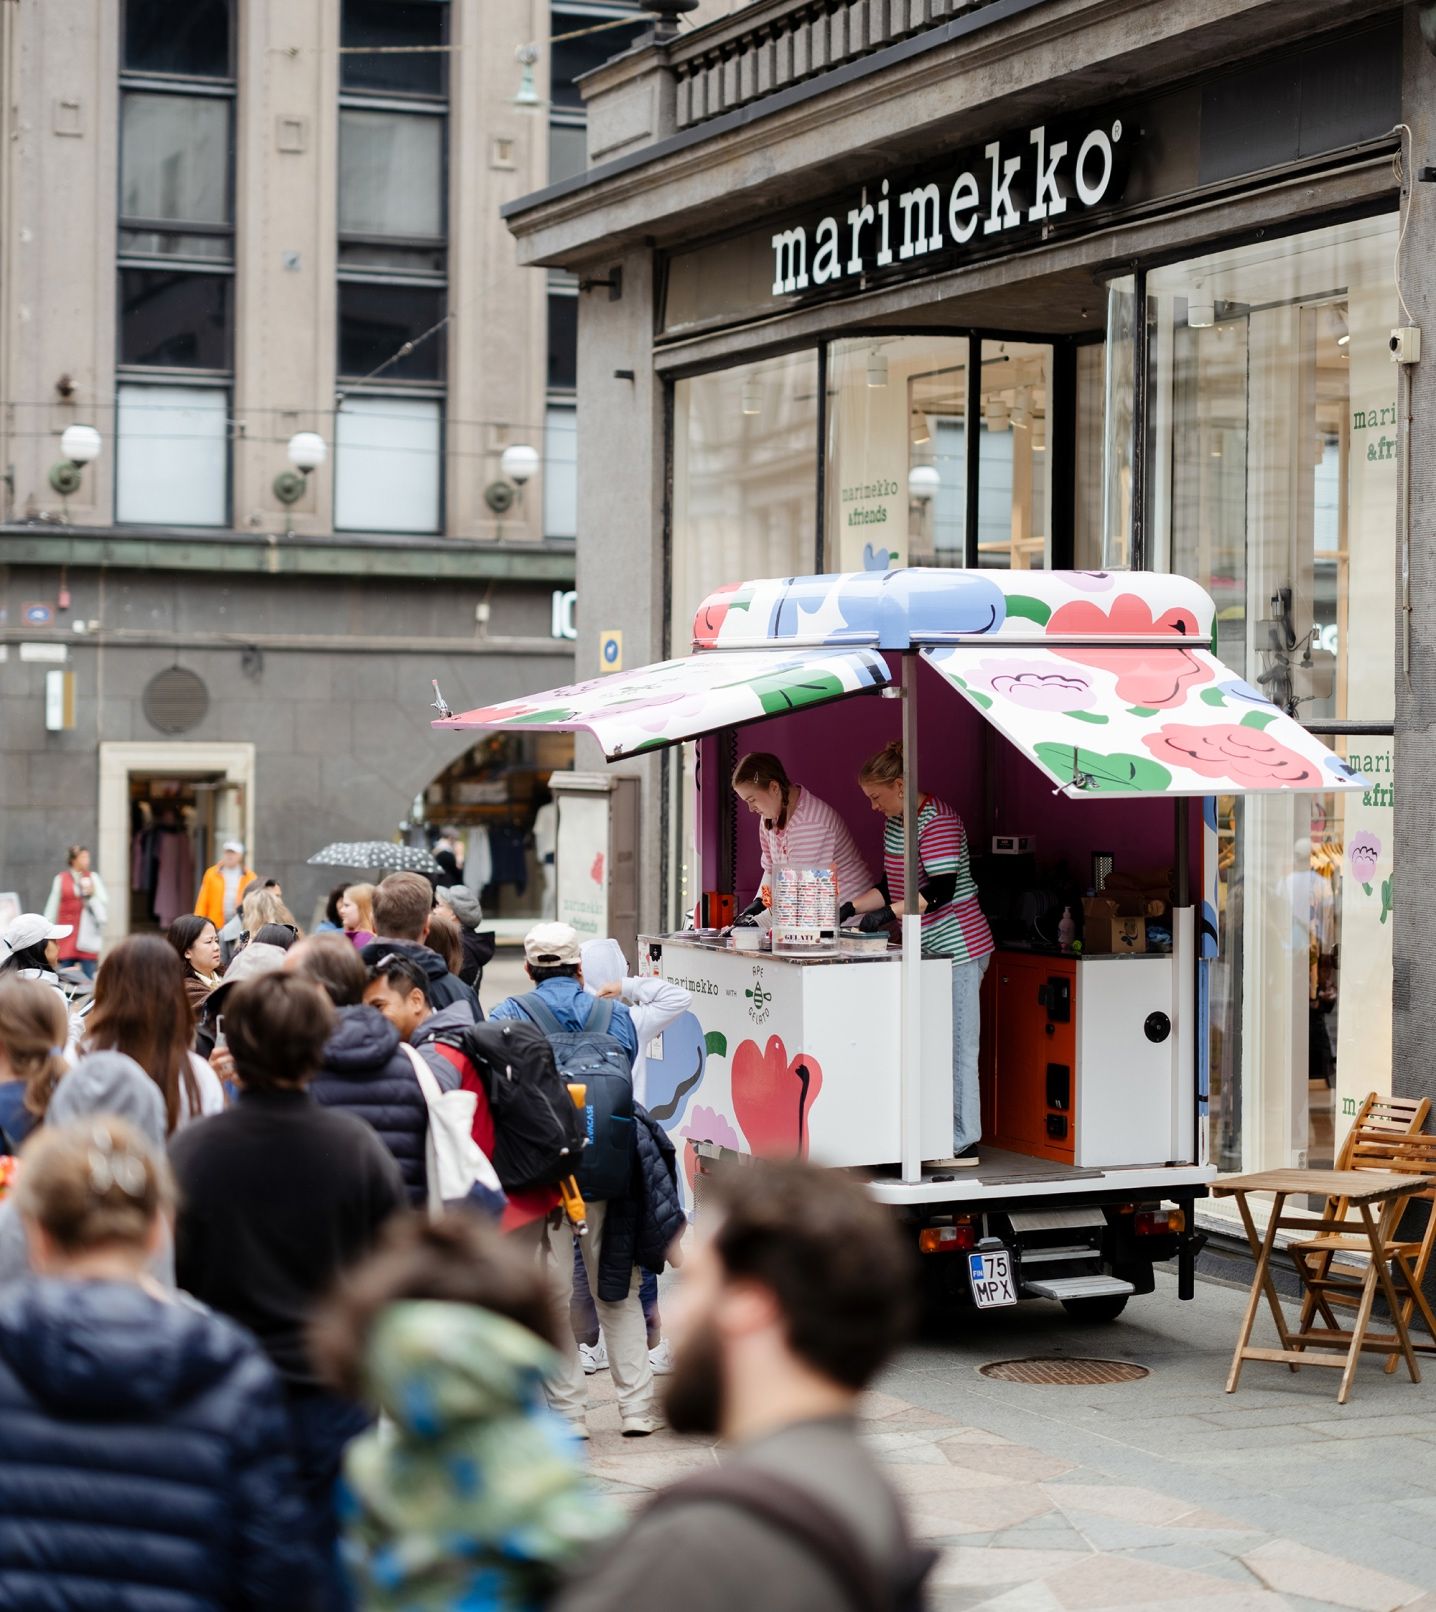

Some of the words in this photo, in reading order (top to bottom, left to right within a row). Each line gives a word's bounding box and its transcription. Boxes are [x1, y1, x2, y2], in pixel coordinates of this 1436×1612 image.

[1353, 402, 1397, 430] mari
[842, 480, 898, 502] marimekko
[1349, 751, 1394, 773] mari
[752, 965, 764, 978] APE
[725, 989, 737, 998] WITH
[748, 1007, 770, 1025] GELATO
[973, 1270, 984, 1278] FIN
[984, 1257, 1007, 1279] 75
[976, 1280, 1012, 1302] MPX
